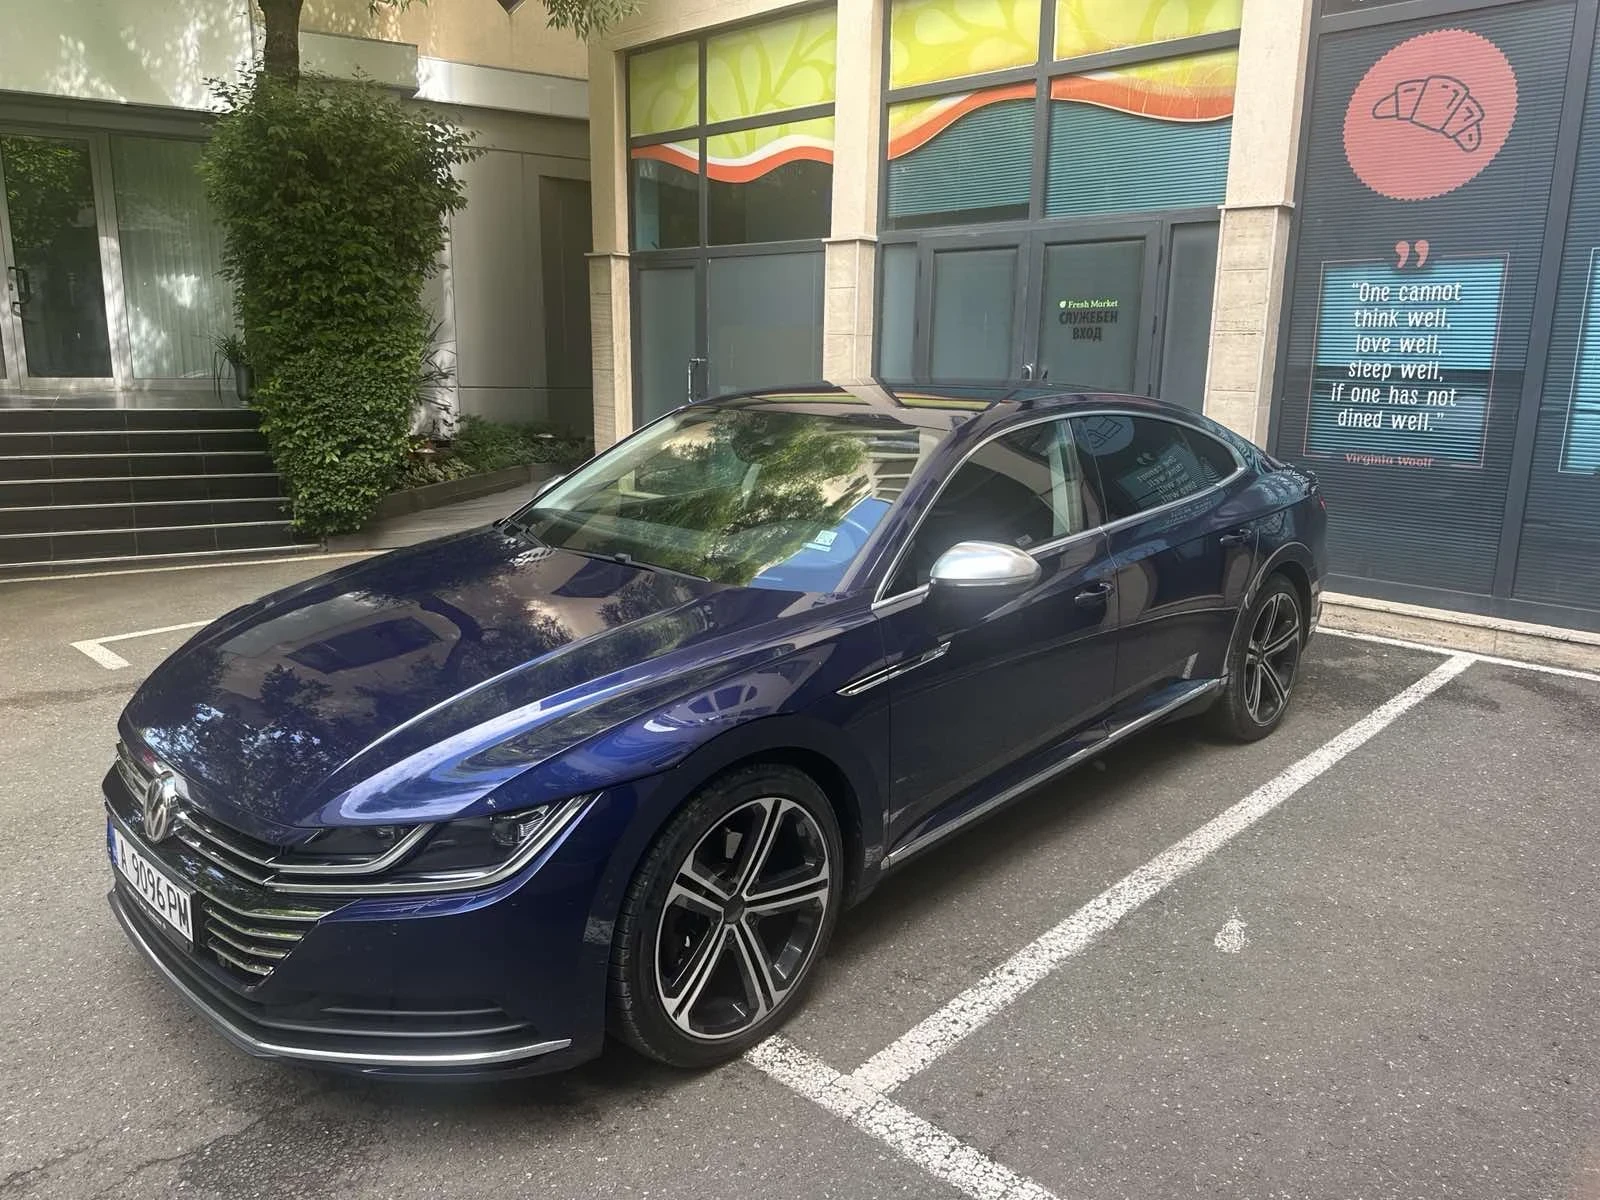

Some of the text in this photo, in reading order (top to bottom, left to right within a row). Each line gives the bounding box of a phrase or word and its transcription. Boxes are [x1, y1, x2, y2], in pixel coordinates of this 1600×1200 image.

[1399, 281, 1462, 301] cannot
[1068, 300, 1090, 309] Fresh
[1354, 308, 1399, 328] think
[1072, 327, 1102, 341] ВХОД
[1355, 333, 1443, 356] love well,
[1348, 359, 1444, 382] sleep well,
[1331, 382, 1458, 408] if one has not
[1338, 408, 1383, 429] dined
